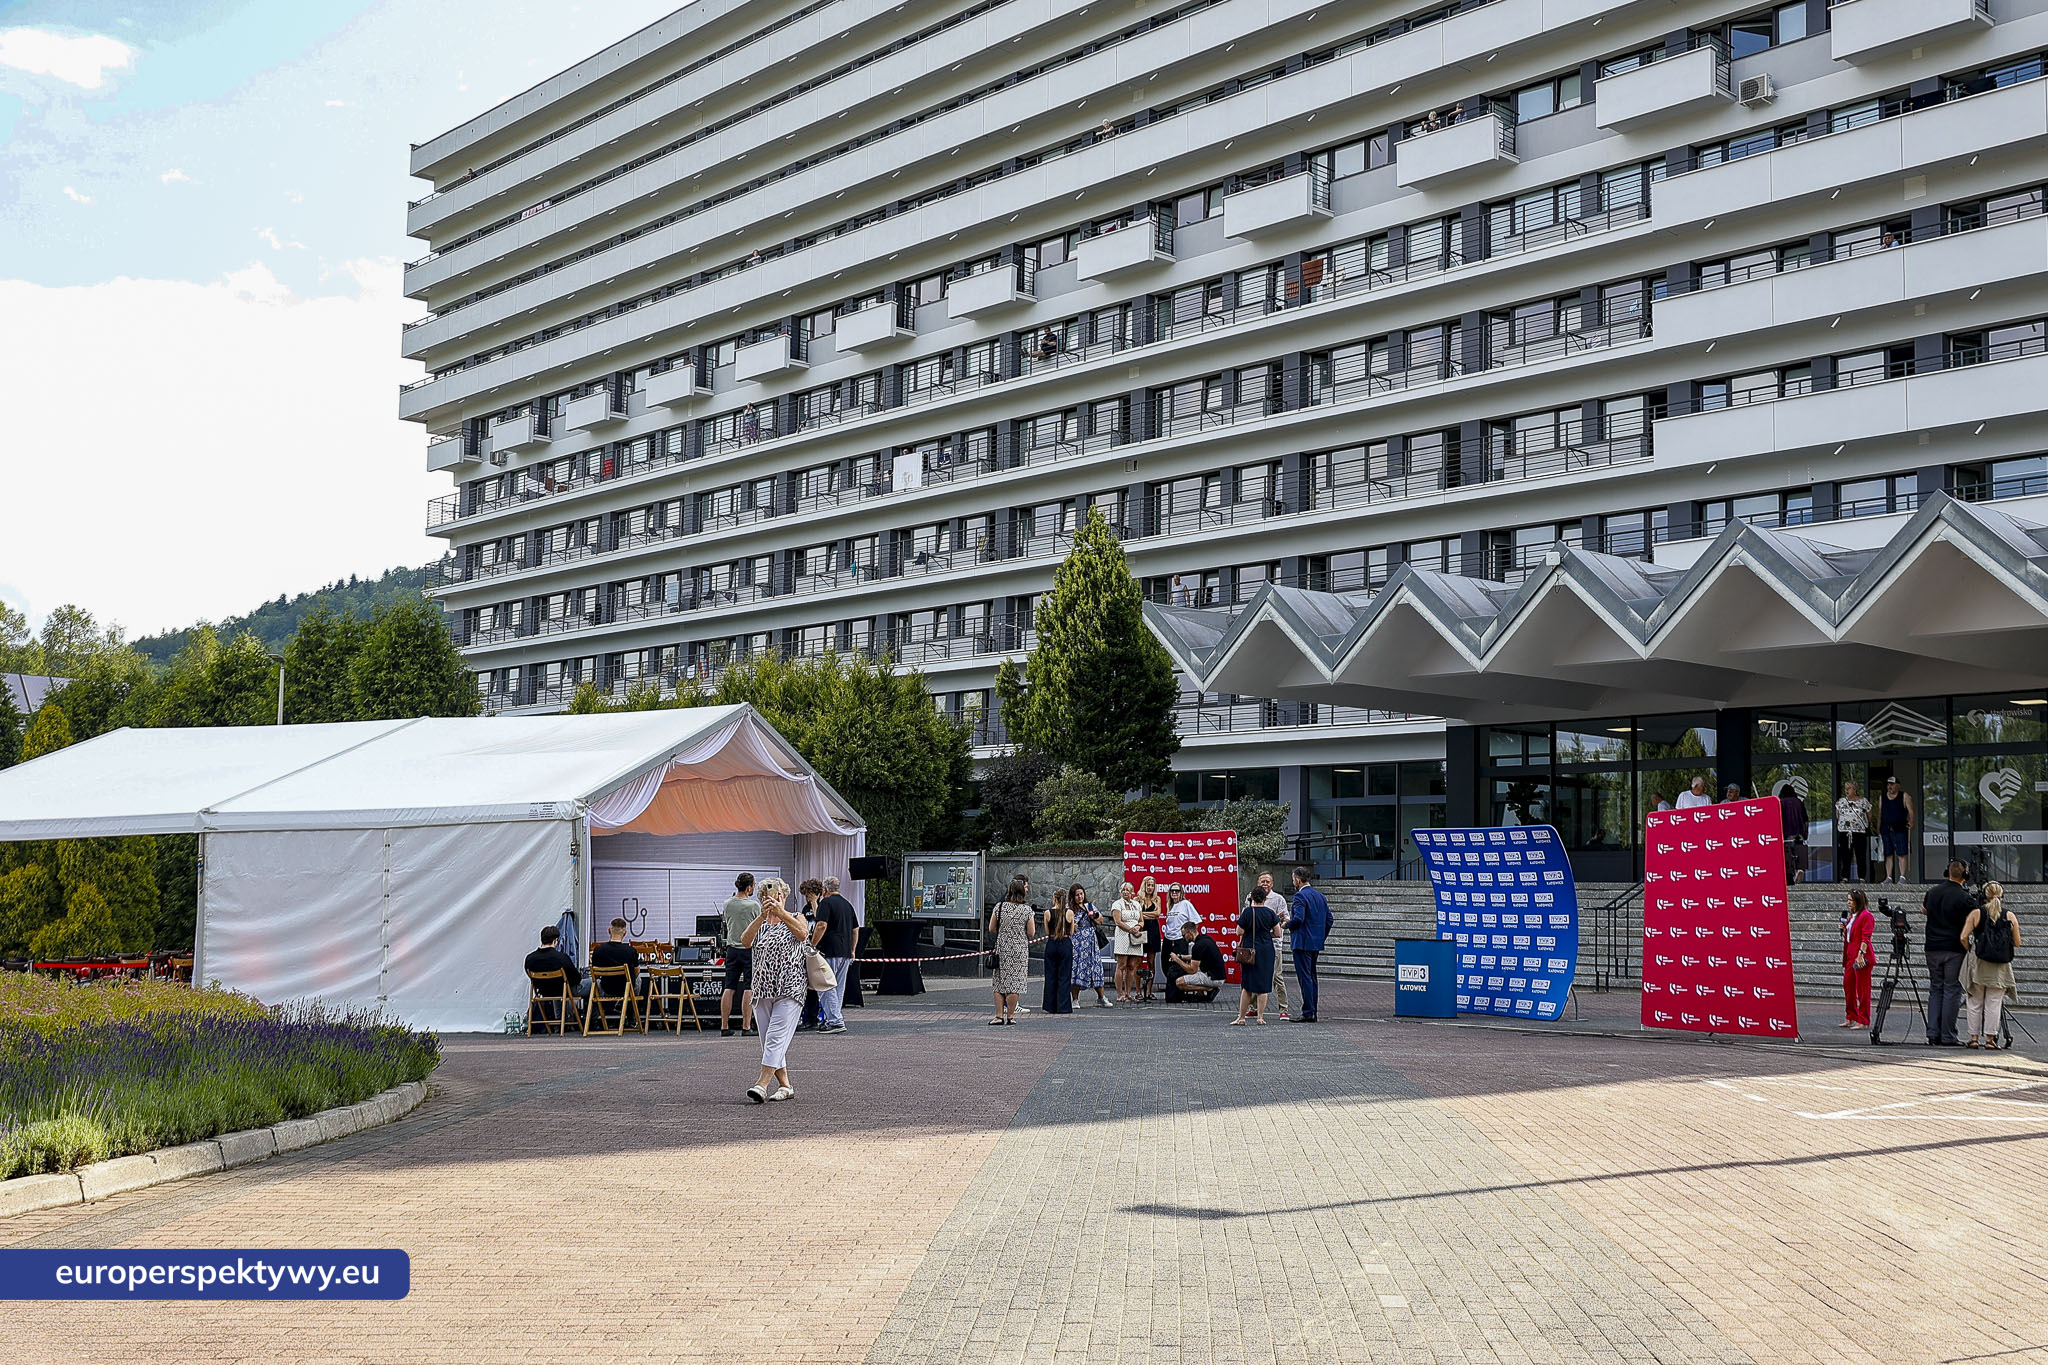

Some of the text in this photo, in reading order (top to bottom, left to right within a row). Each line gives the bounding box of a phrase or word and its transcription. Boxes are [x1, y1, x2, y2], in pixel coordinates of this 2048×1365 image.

[1982, 832, 2023, 843] Równica
[1181, 884, 1210, 893] ACHODNI
[692, 981, 723, 989] STAGE
[1400, 984, 1427, 992] KATOWICE
[692, 987, 722, 995] CREW
